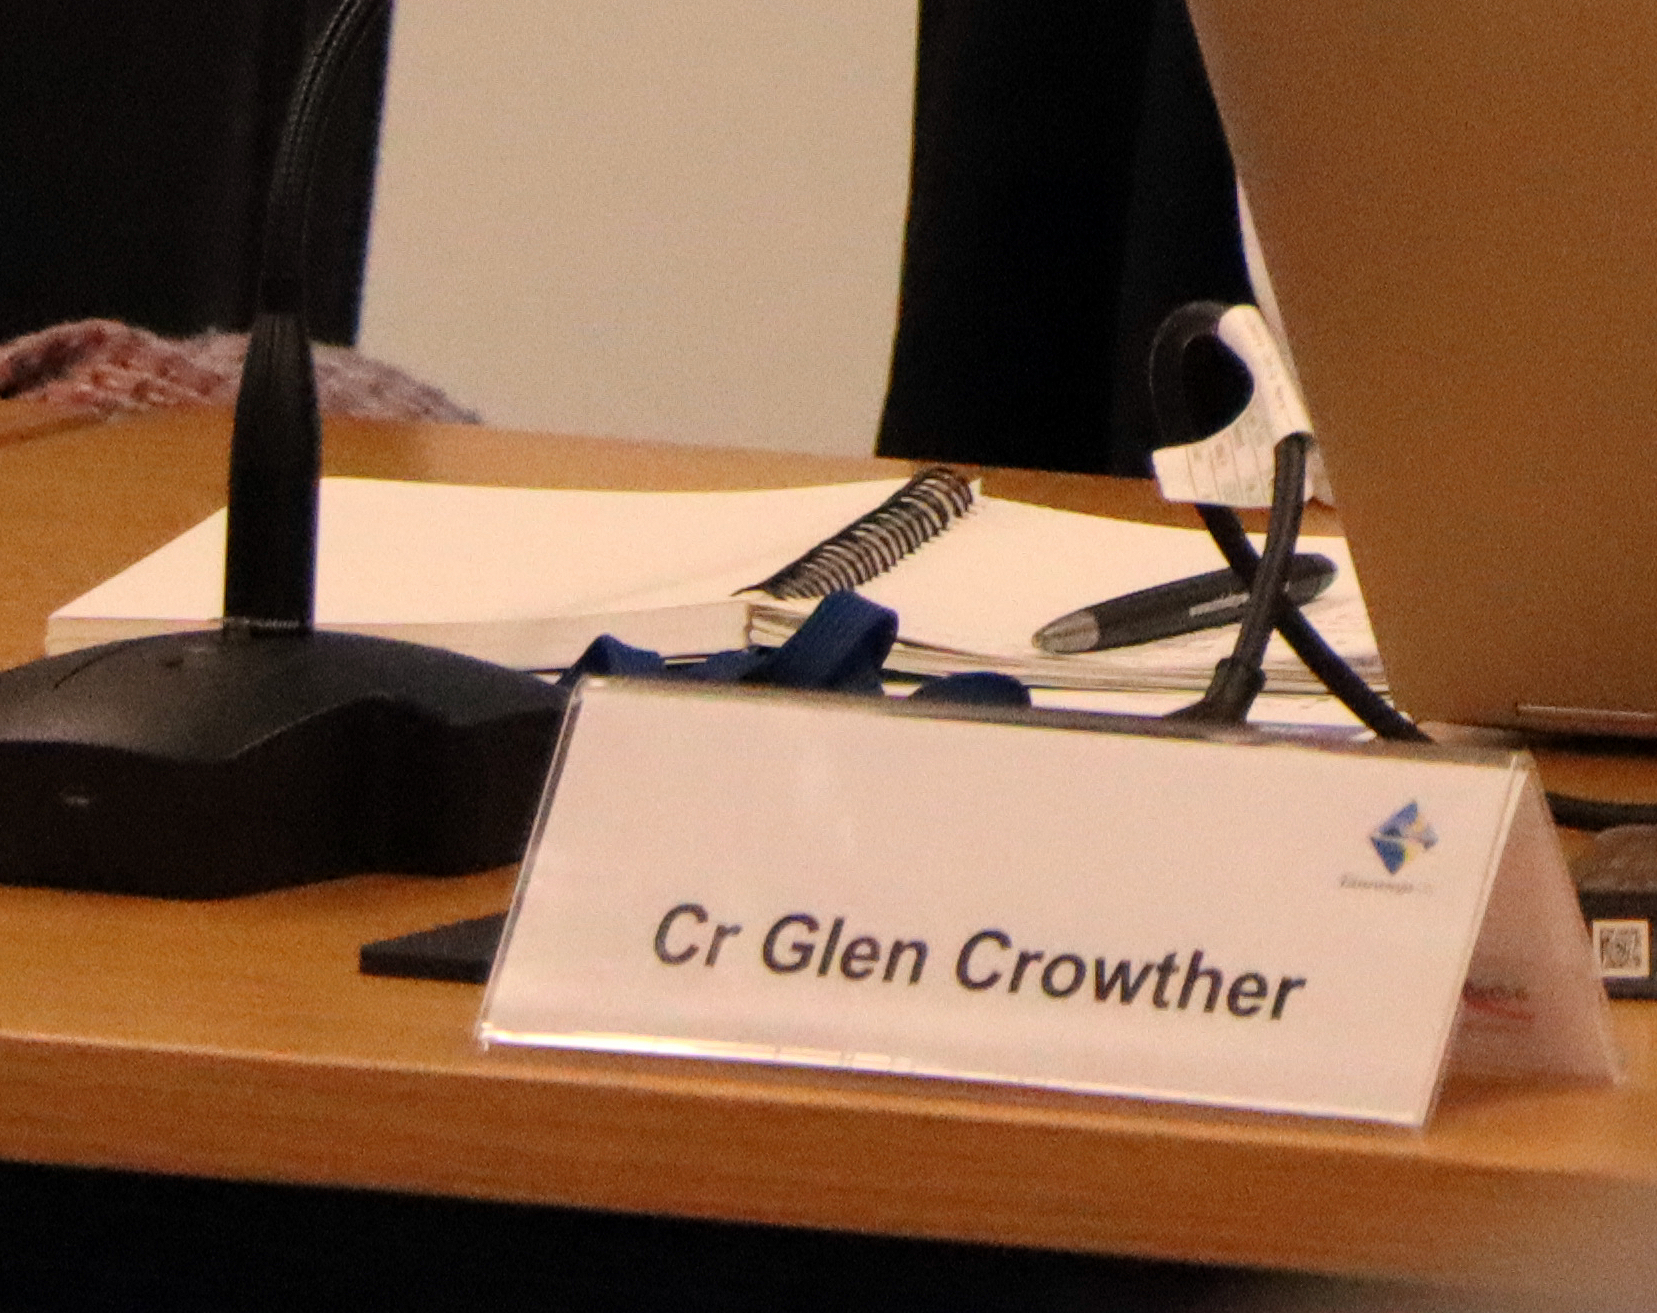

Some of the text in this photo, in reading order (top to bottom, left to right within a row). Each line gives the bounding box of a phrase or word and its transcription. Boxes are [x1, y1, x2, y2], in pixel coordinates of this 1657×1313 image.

[653, 902, 1307, 1021] Cr Glen Crowther
